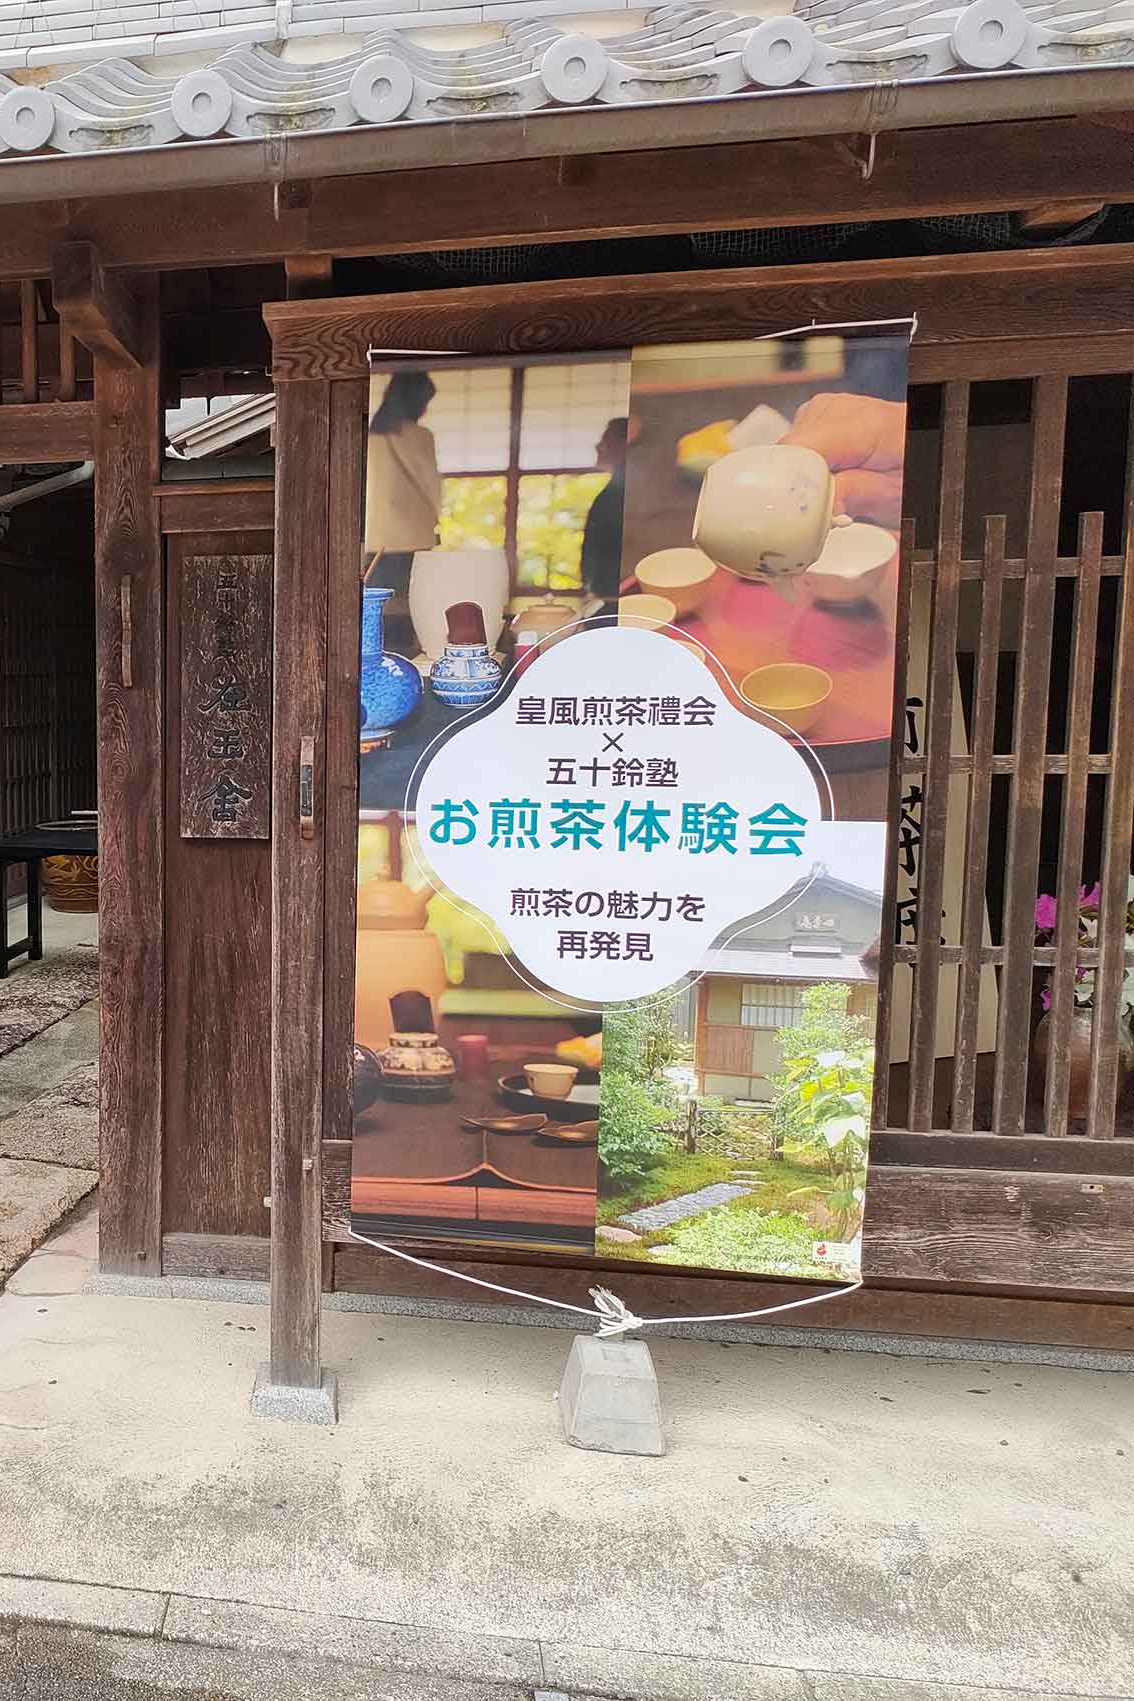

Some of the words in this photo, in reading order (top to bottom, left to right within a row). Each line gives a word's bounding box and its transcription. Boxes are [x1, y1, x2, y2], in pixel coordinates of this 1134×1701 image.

[514, 695, 717, 727] 皇風煎茶禮会
[546, 757, 680, 788] 五十鈴塾
[428, 798, 809, 858] お煎茶体験会
[509, 888, 706, 923] 煎茶の魅力を
[556, 930, 654, 962] 再発見
